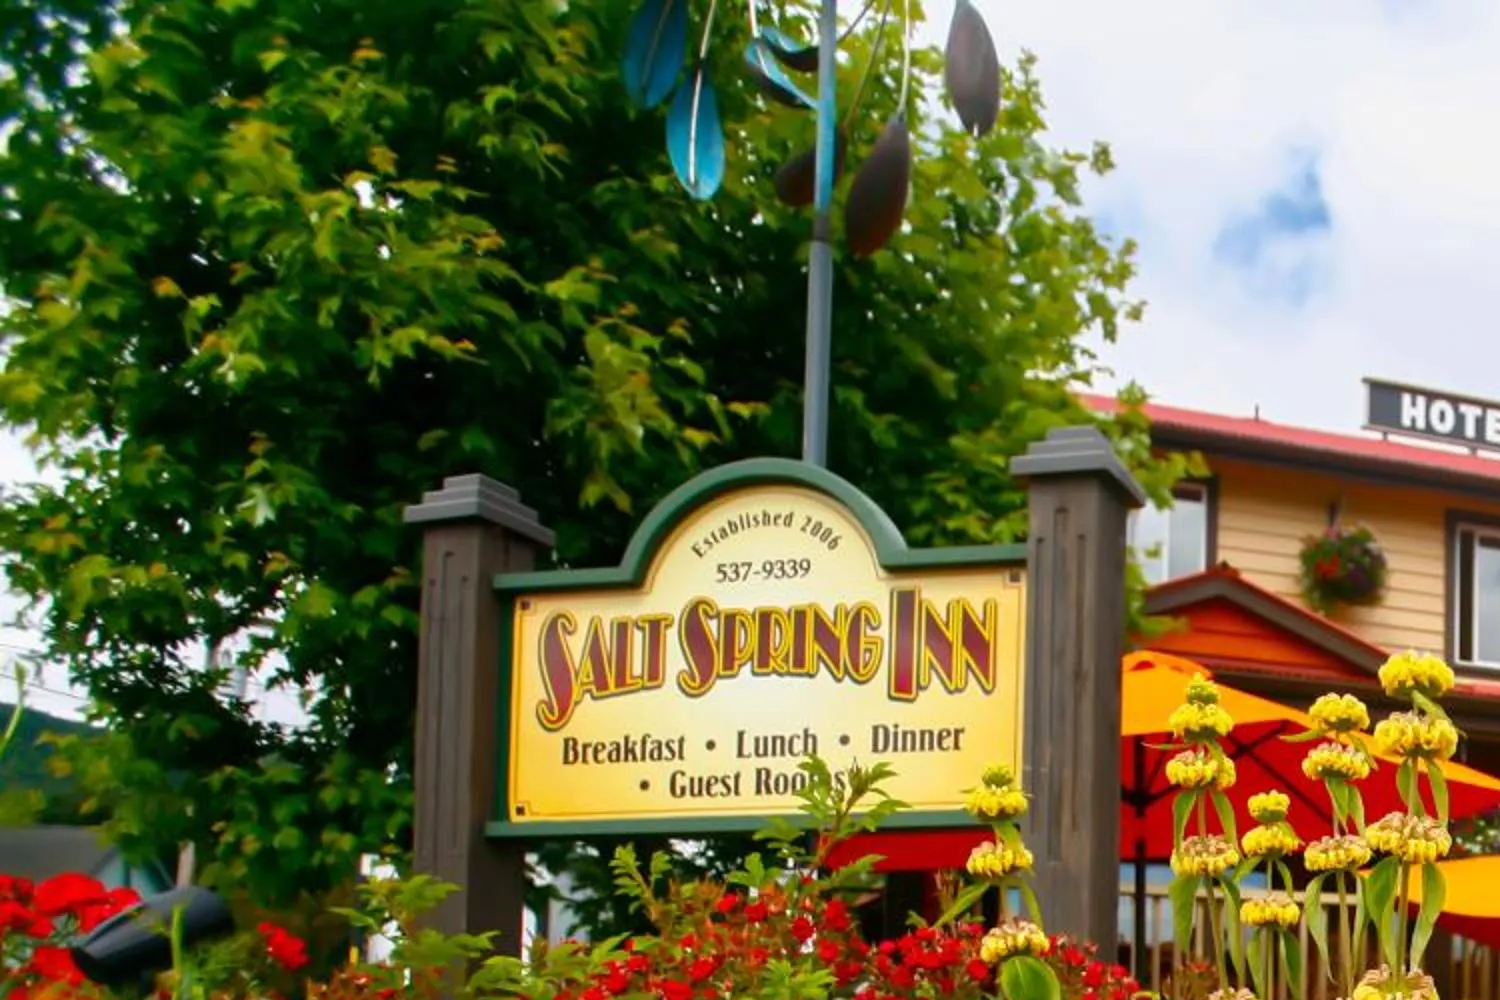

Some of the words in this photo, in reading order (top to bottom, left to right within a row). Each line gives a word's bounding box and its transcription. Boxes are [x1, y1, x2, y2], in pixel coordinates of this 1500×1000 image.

[690, 509, 795, 559] Established
[800, 515, 842, 552] 2006
[715, 558, 812, 584] 537-9339
[537, 609, 674, 732] SALT
[677, 596, 884, 697] SPRING
[887, 588, 997, 701] INN
[561, 733, 687, 766] Breakfast
[735, 728, 819, 759] Lunch
[870, 723, 966, 755] Dinner
[668, 770, 742, 800] Guest
[755, 766, 846, 797] Roos
